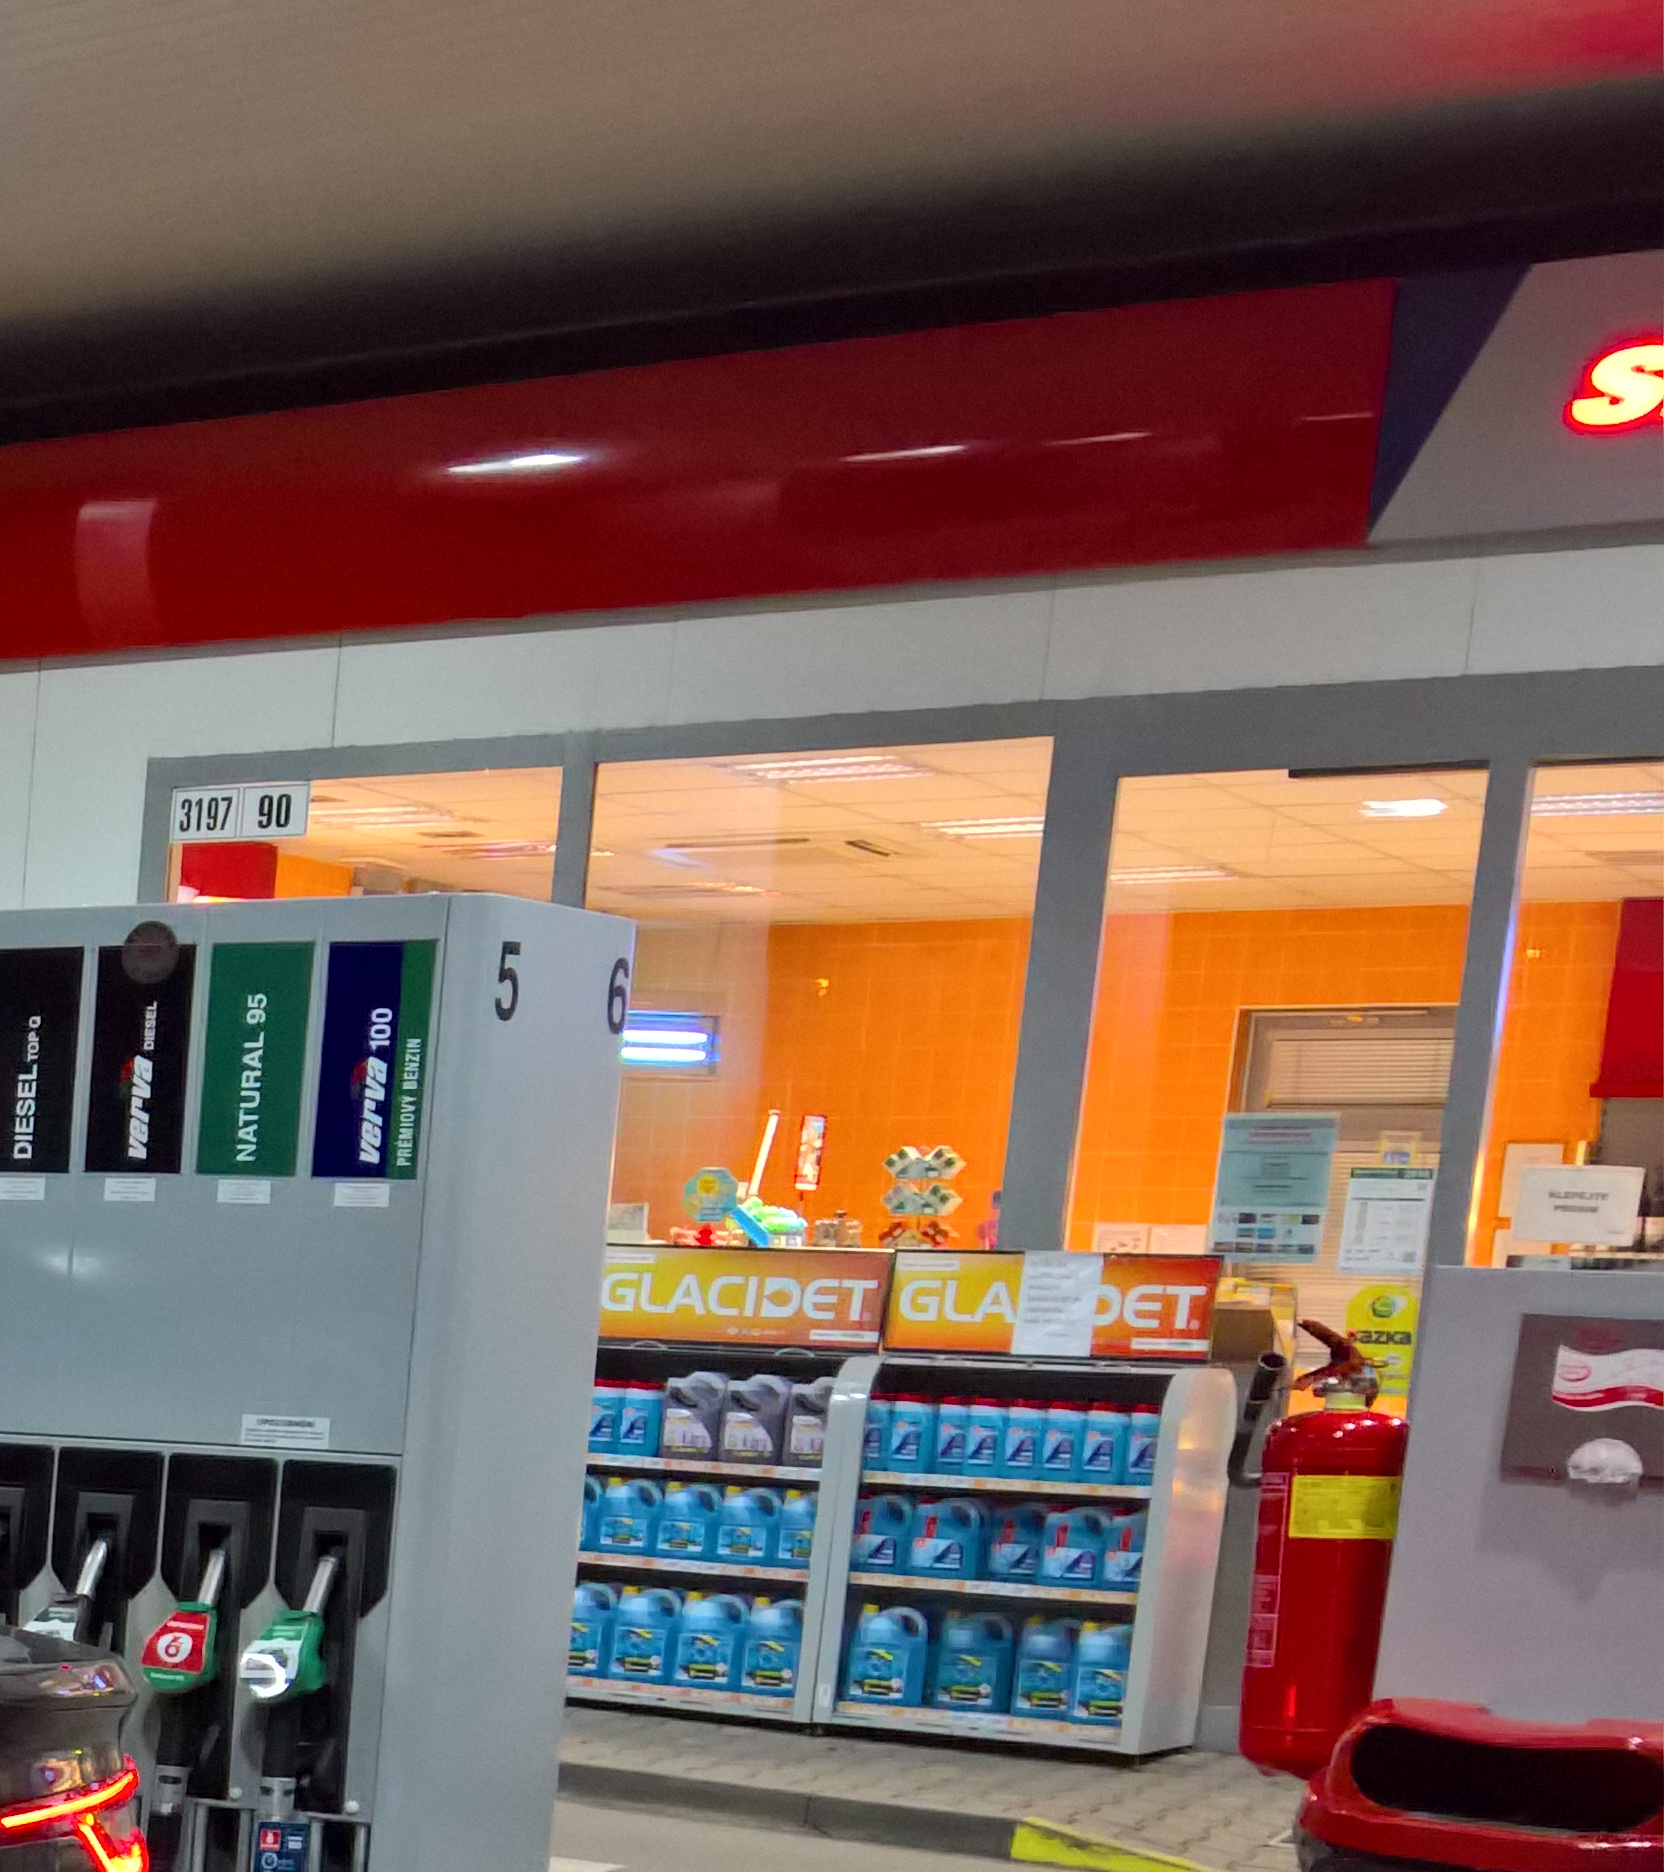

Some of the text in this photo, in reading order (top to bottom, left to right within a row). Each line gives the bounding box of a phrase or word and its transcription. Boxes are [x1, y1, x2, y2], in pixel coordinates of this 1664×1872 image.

[178, 795, 234, 833] 3197
[257, 793, 293, 829] 90
[245, 992, 269, 1026] 95
[494, 940, 522, 1022] 5
[606, 957, 630, 1035] 6
[368, 1006, 394, 1051] 100
[402, 1037, 423, 1091] BENZIN
[13, 1062, 39, 1161] DIESEL
[26, 1030, 41, 1064] TOP
[127, 1054, 154, 1161] verva
[143, 1000, 159, 1051] DIESEL
[235, 1031, 265, 1163] NATURAL
[357, 1055, 389, 1165] verva
